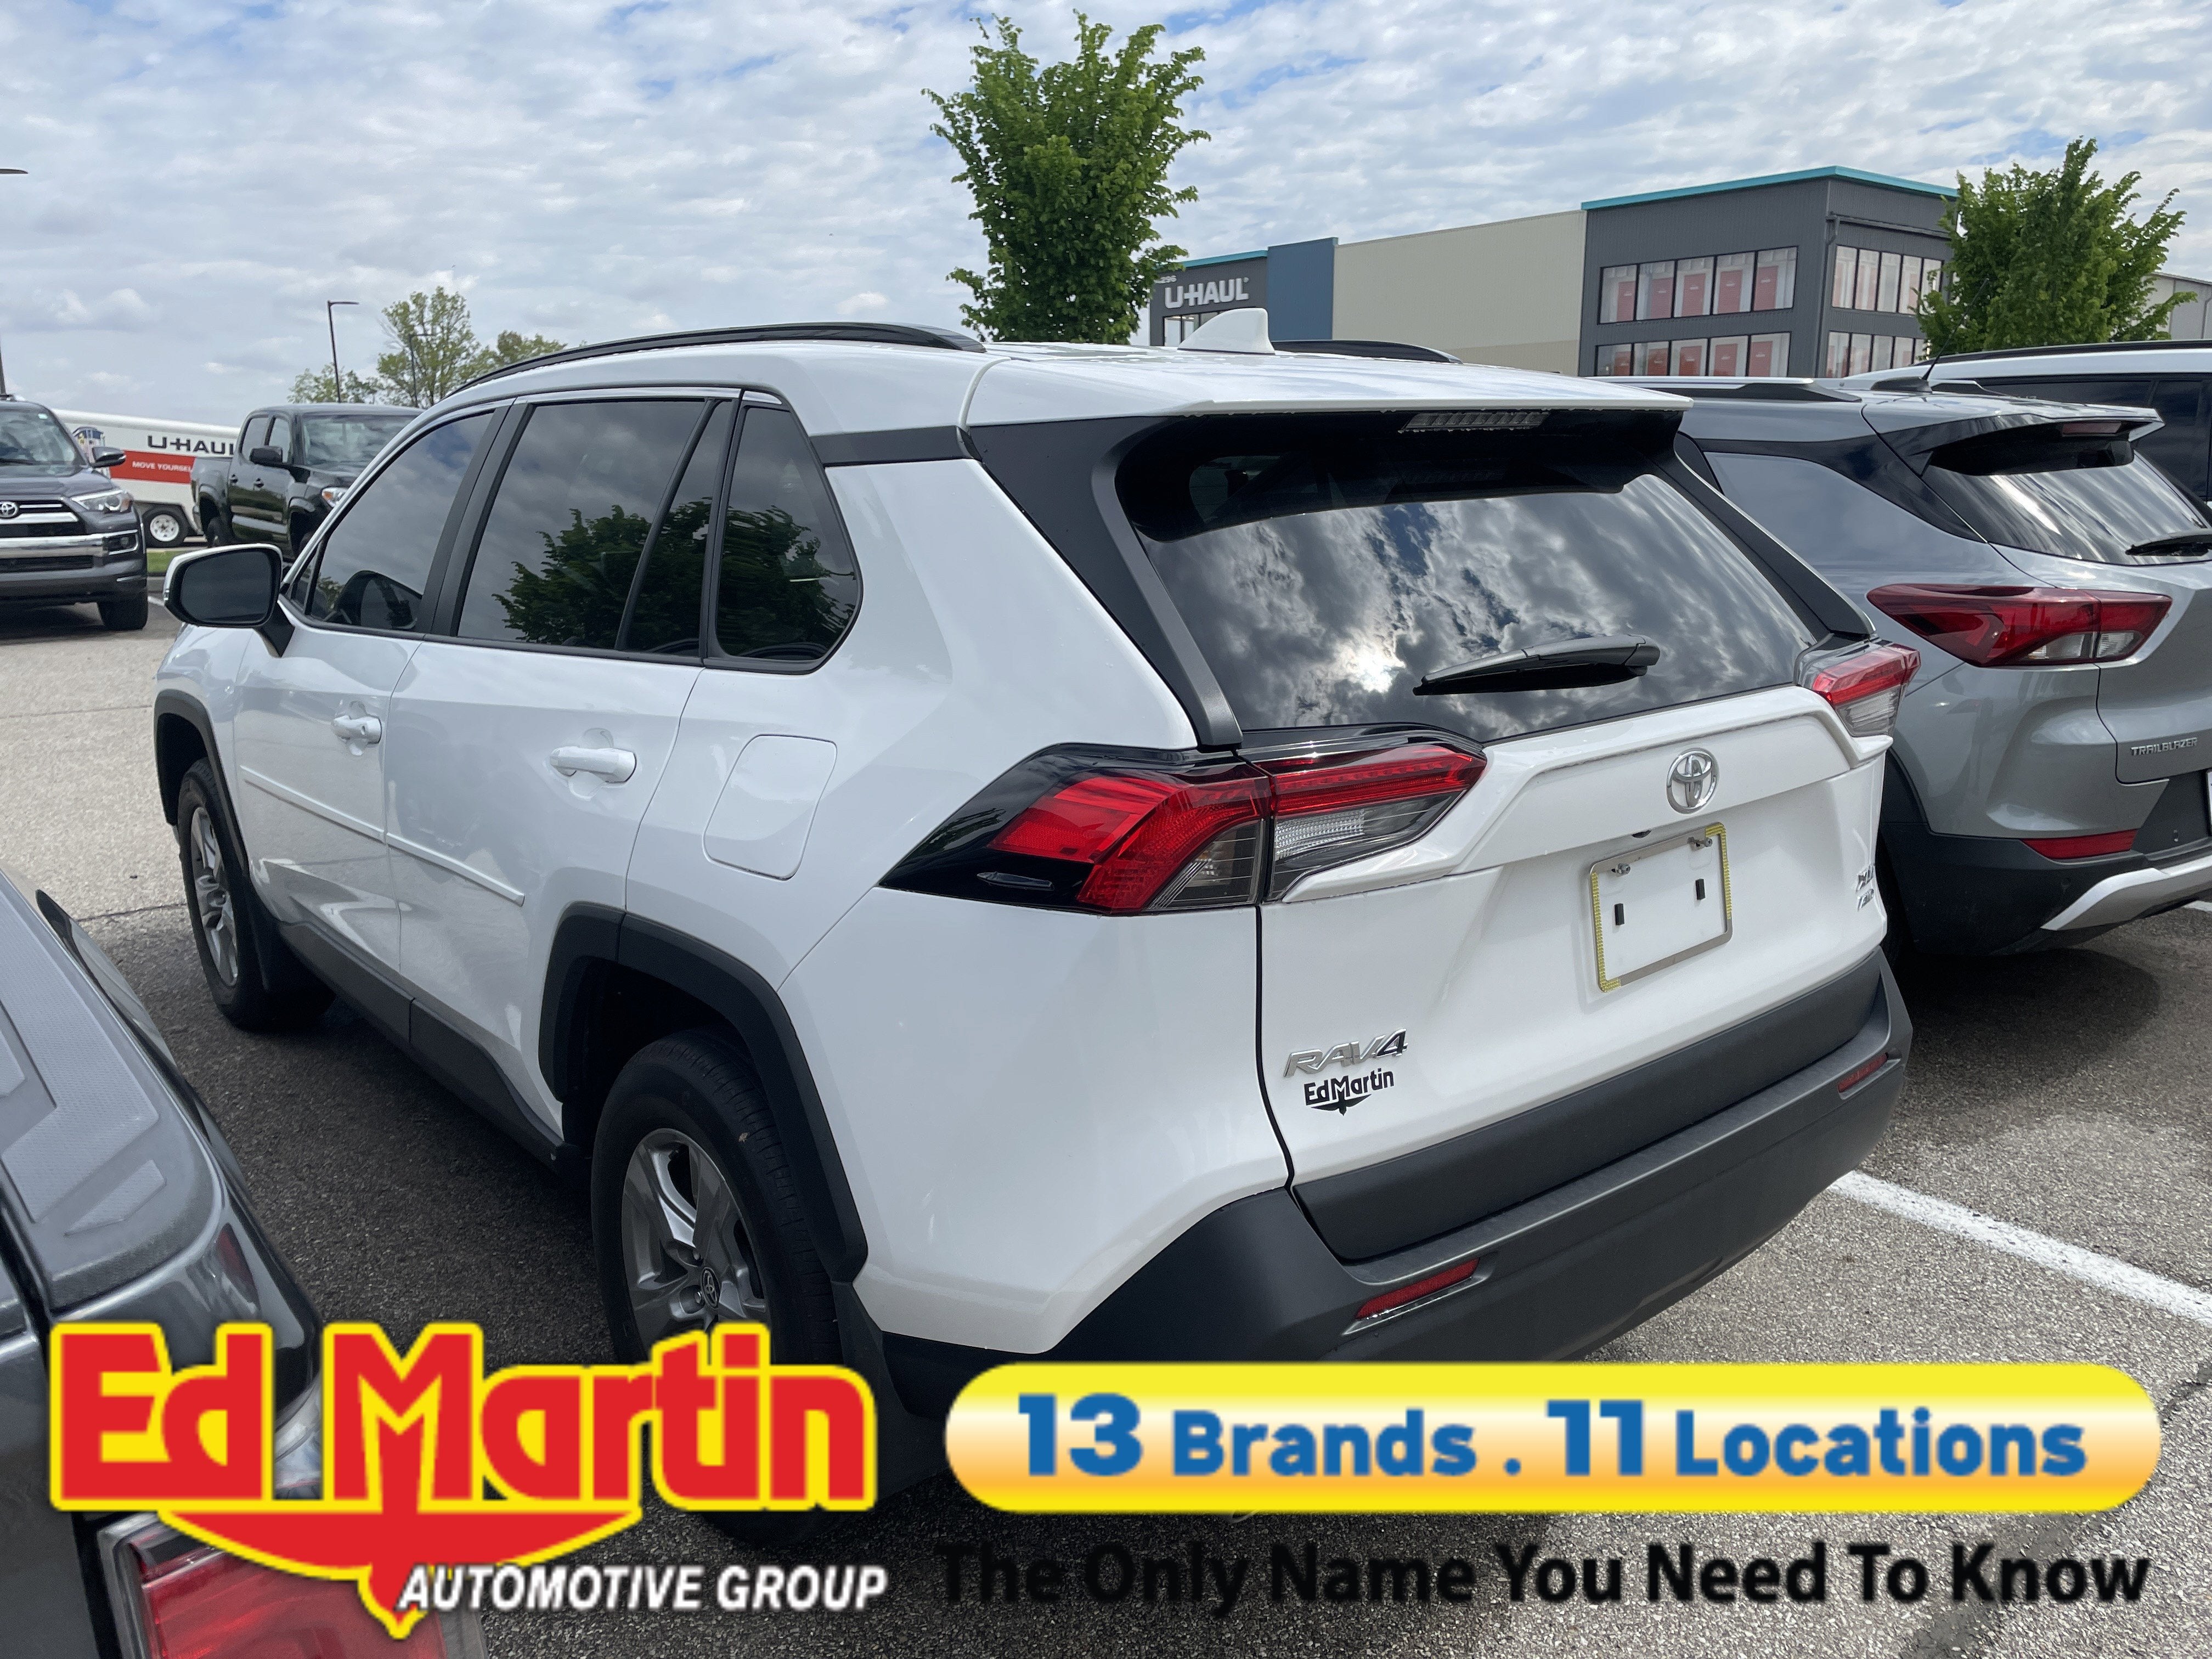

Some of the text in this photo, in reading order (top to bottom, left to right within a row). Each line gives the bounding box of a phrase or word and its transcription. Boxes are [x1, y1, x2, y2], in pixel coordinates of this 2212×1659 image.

[1165, 278, 1249, 309] U-HAUL
[132, 461, 155, 470] MOVE
[2130, 737, 2198, 756] TRAILBLAZER
[1283, 1028, 1409, 1077] RAV4
